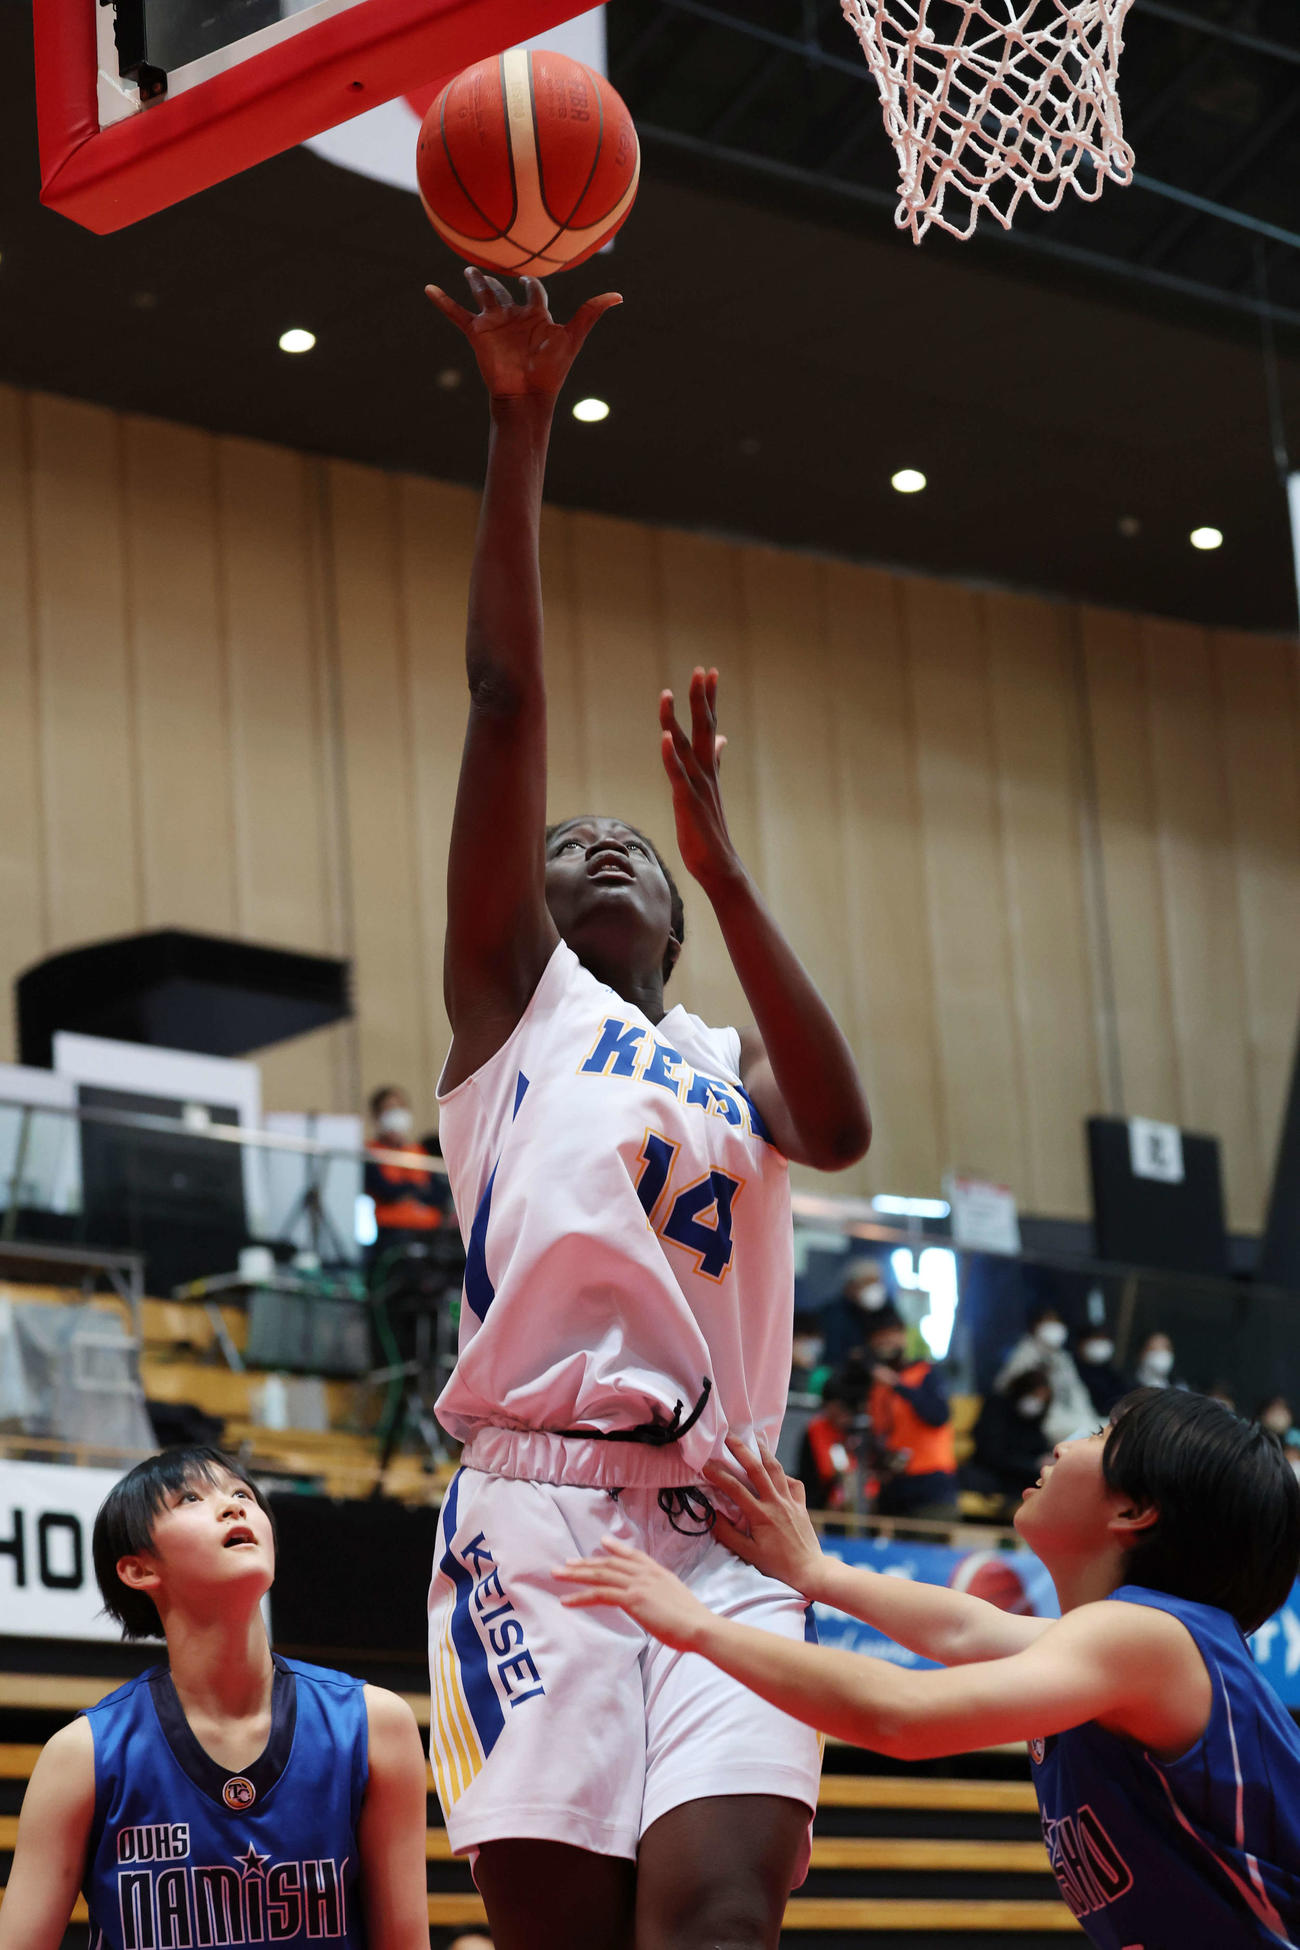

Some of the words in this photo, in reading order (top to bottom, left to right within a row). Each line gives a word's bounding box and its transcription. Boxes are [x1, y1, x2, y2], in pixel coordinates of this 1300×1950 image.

[636, 1127, 746, 1285] 14
[461, 1530, 546, 1709] KEISEI
[117, 1855, 350, 1950] NAMISH
